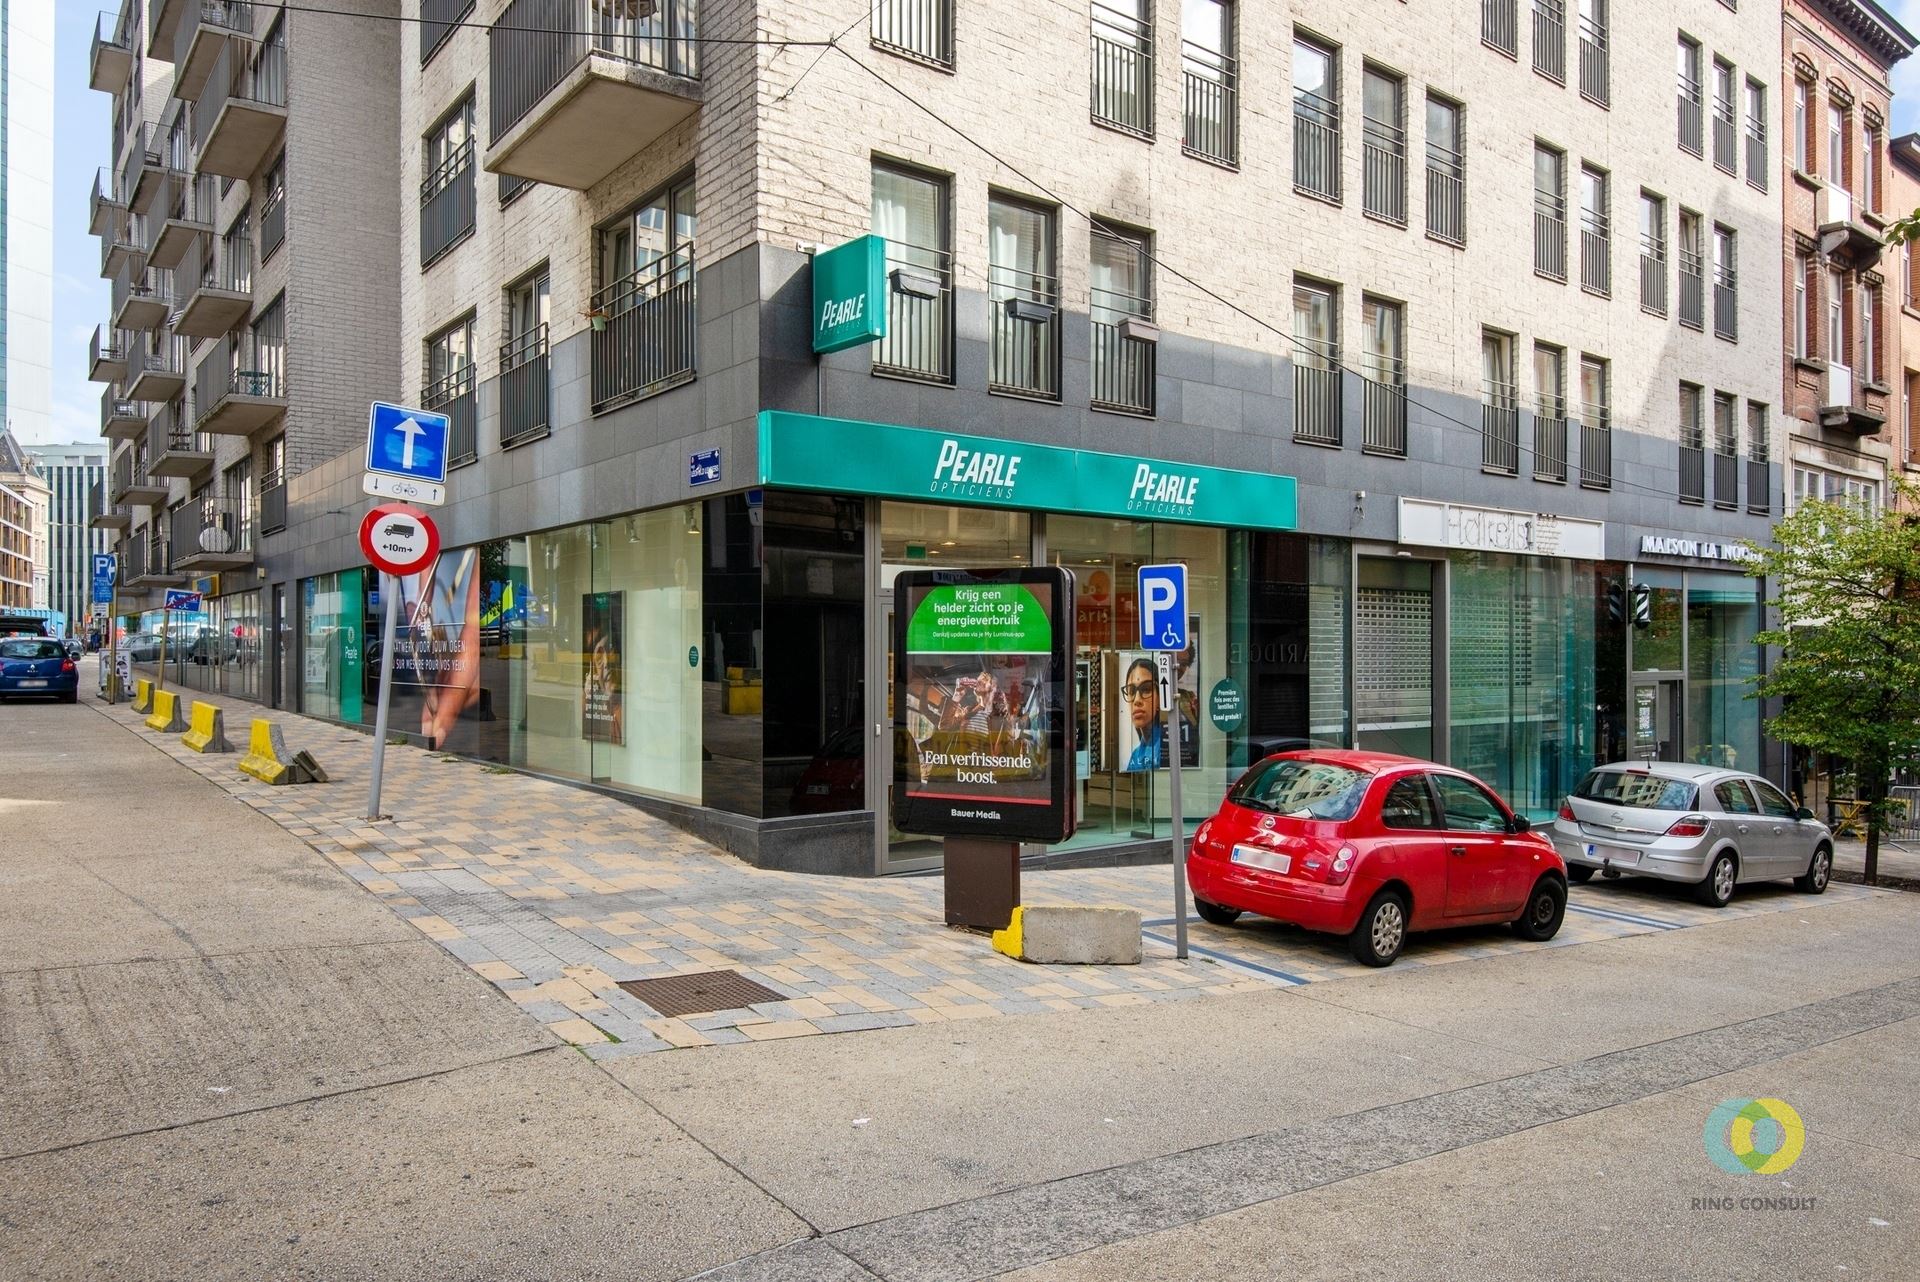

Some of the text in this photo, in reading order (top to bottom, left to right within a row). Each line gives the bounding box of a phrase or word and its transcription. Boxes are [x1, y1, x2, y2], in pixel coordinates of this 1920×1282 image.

[820, 293, 865, 330] PEARLE
[934, 439, 1021, 486] PEARLE
[930, 481, 1013, 499] OPTICIENS
[1130, 463, 1199, 505] PEARLE
[1127, 500, 1193, 516] OPTICIENS
[389, 543, 407, 553] 10m
[1641, 535, 1698, 556] MAISON
[1700, 542, 1718, 559] LA
[955, 590, 1001, 601] Krijg een
[934, 602, 1024, 614] helder zicht op je
[1143, 577, 1177, 636] P
[937, 615, 1020, 628] energieverbruik
[932, 631, 950, 639] Dankzij
[951, 631, 970, 639] updates
[984, 631, 992, 639] My
[449, 640, 466, 653] OGEN
[1159, 657, 1168, 666] 12
[925, 750, 1032, 769] Een verfrissende
[957, 768, 998, 785] boost.
[951, 808, 1001, 820] Bauer Media
